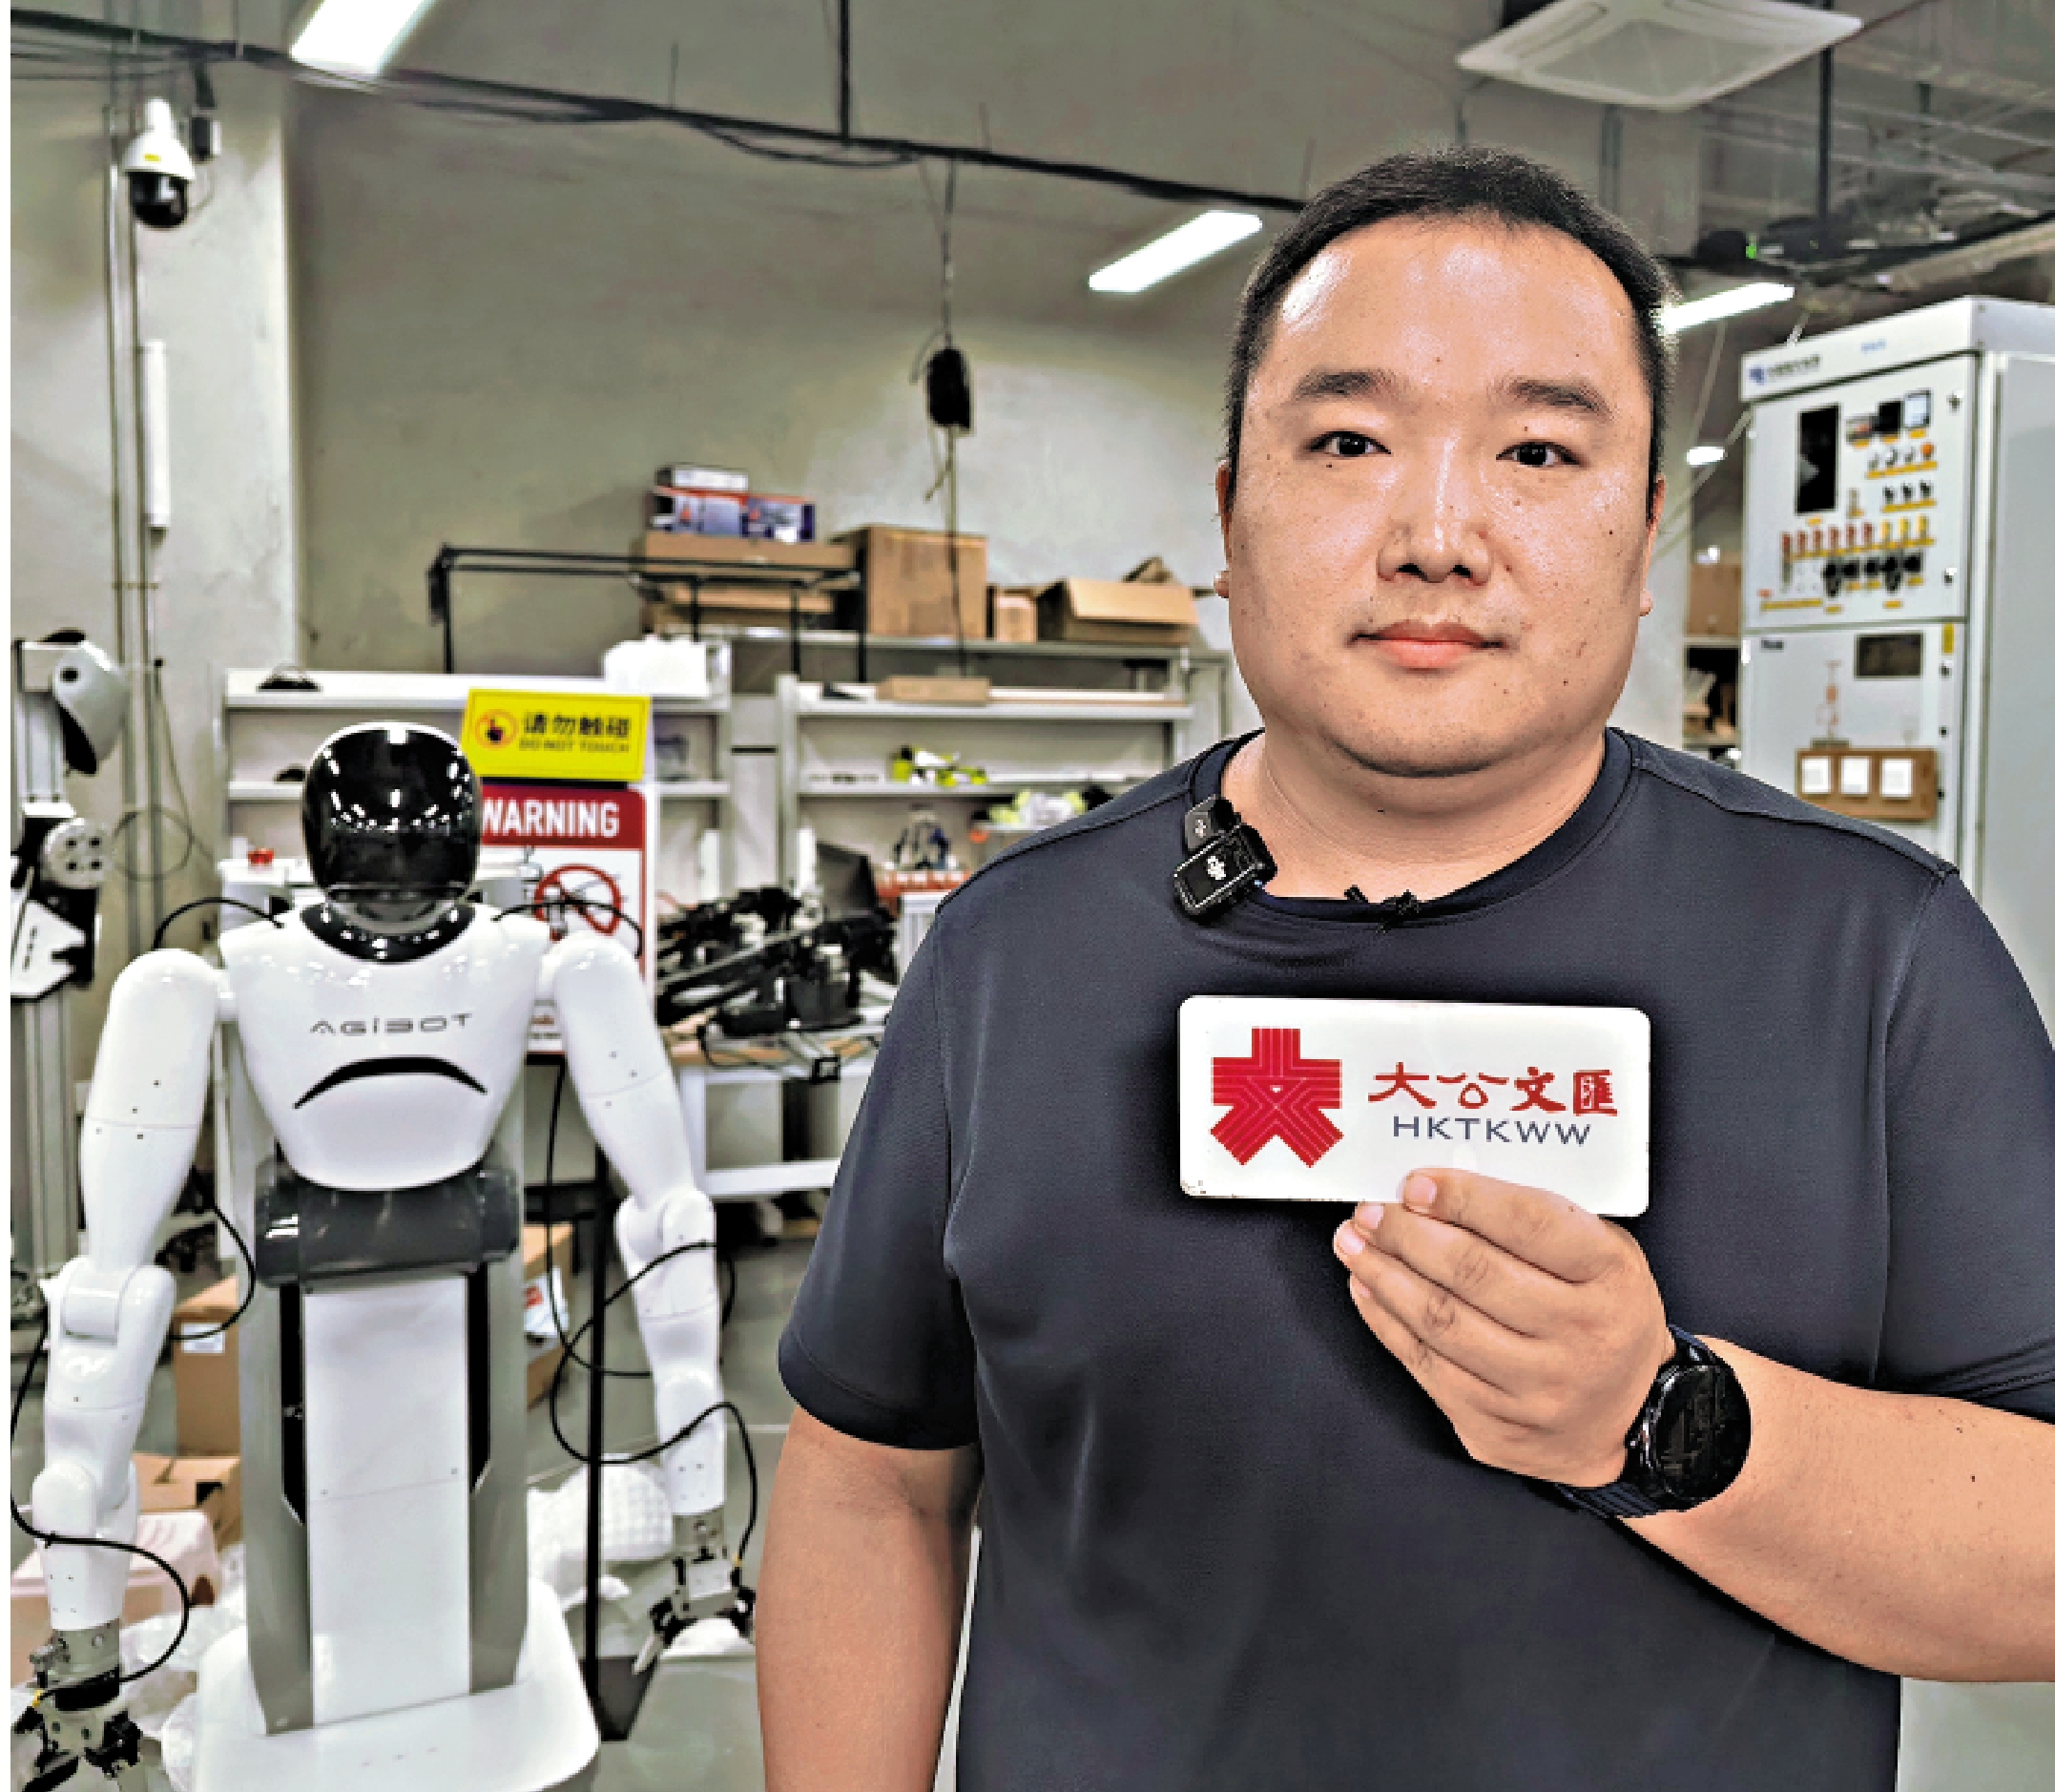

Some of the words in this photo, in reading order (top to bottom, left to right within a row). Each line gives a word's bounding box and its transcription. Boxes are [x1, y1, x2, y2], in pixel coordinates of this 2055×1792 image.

[482, 798, 620, 839] WARNING
[1367, 1062, 1618, 1116] 大公文匯
[1394, 1115, 1590, 1145] HKTKWW
